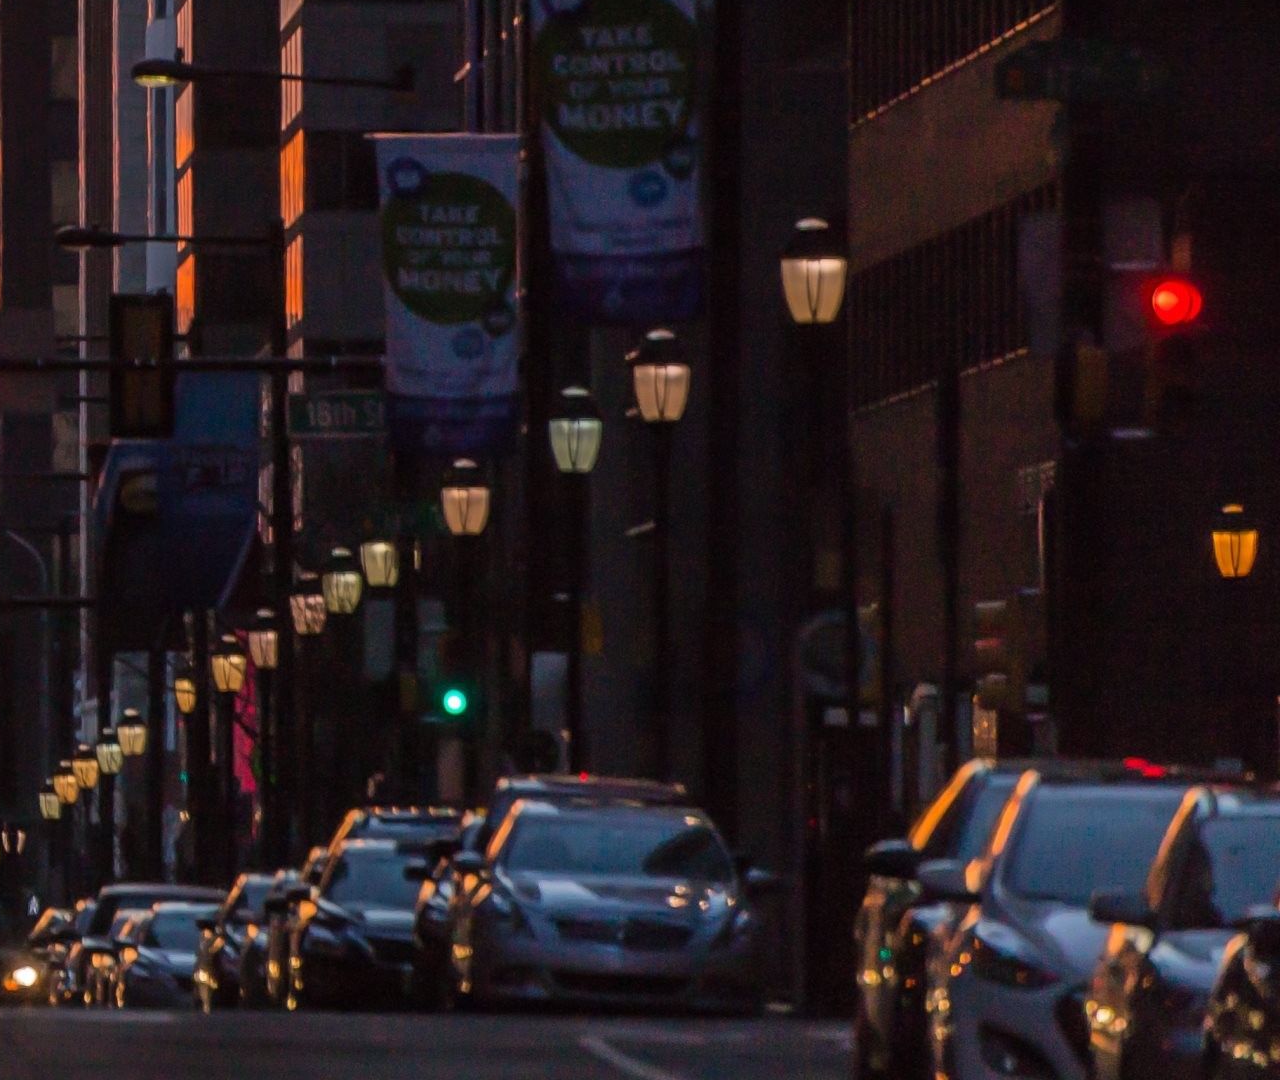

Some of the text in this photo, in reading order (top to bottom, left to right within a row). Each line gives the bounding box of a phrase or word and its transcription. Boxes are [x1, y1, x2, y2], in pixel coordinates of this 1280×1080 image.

[580, 26, 651, 49] TAKE
[552, 50, 685, 75] CONTROL
[557, 99, 687, 130] MONEY
[416, 204, 479, 224] TAKE
[396, 224, 503, 246] CONTROL
[397, 266, 503, 293] MONEY
[307, 399, 357, 427] 18th
